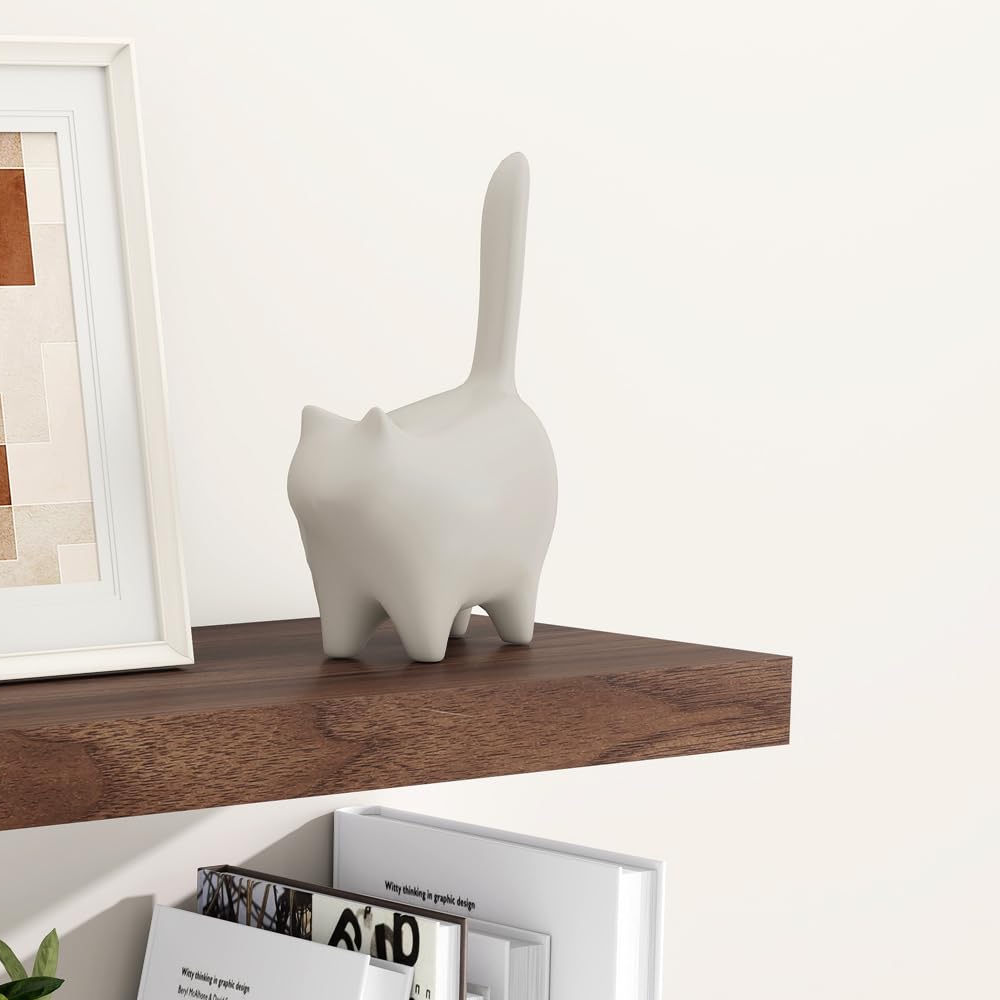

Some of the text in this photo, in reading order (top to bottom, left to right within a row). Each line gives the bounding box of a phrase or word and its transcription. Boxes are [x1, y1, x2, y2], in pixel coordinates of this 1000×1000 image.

[384, 880, 475, 912] Witty thinking in graphic design
[181, 966, 250, 995] Witty thinking in graphic design
